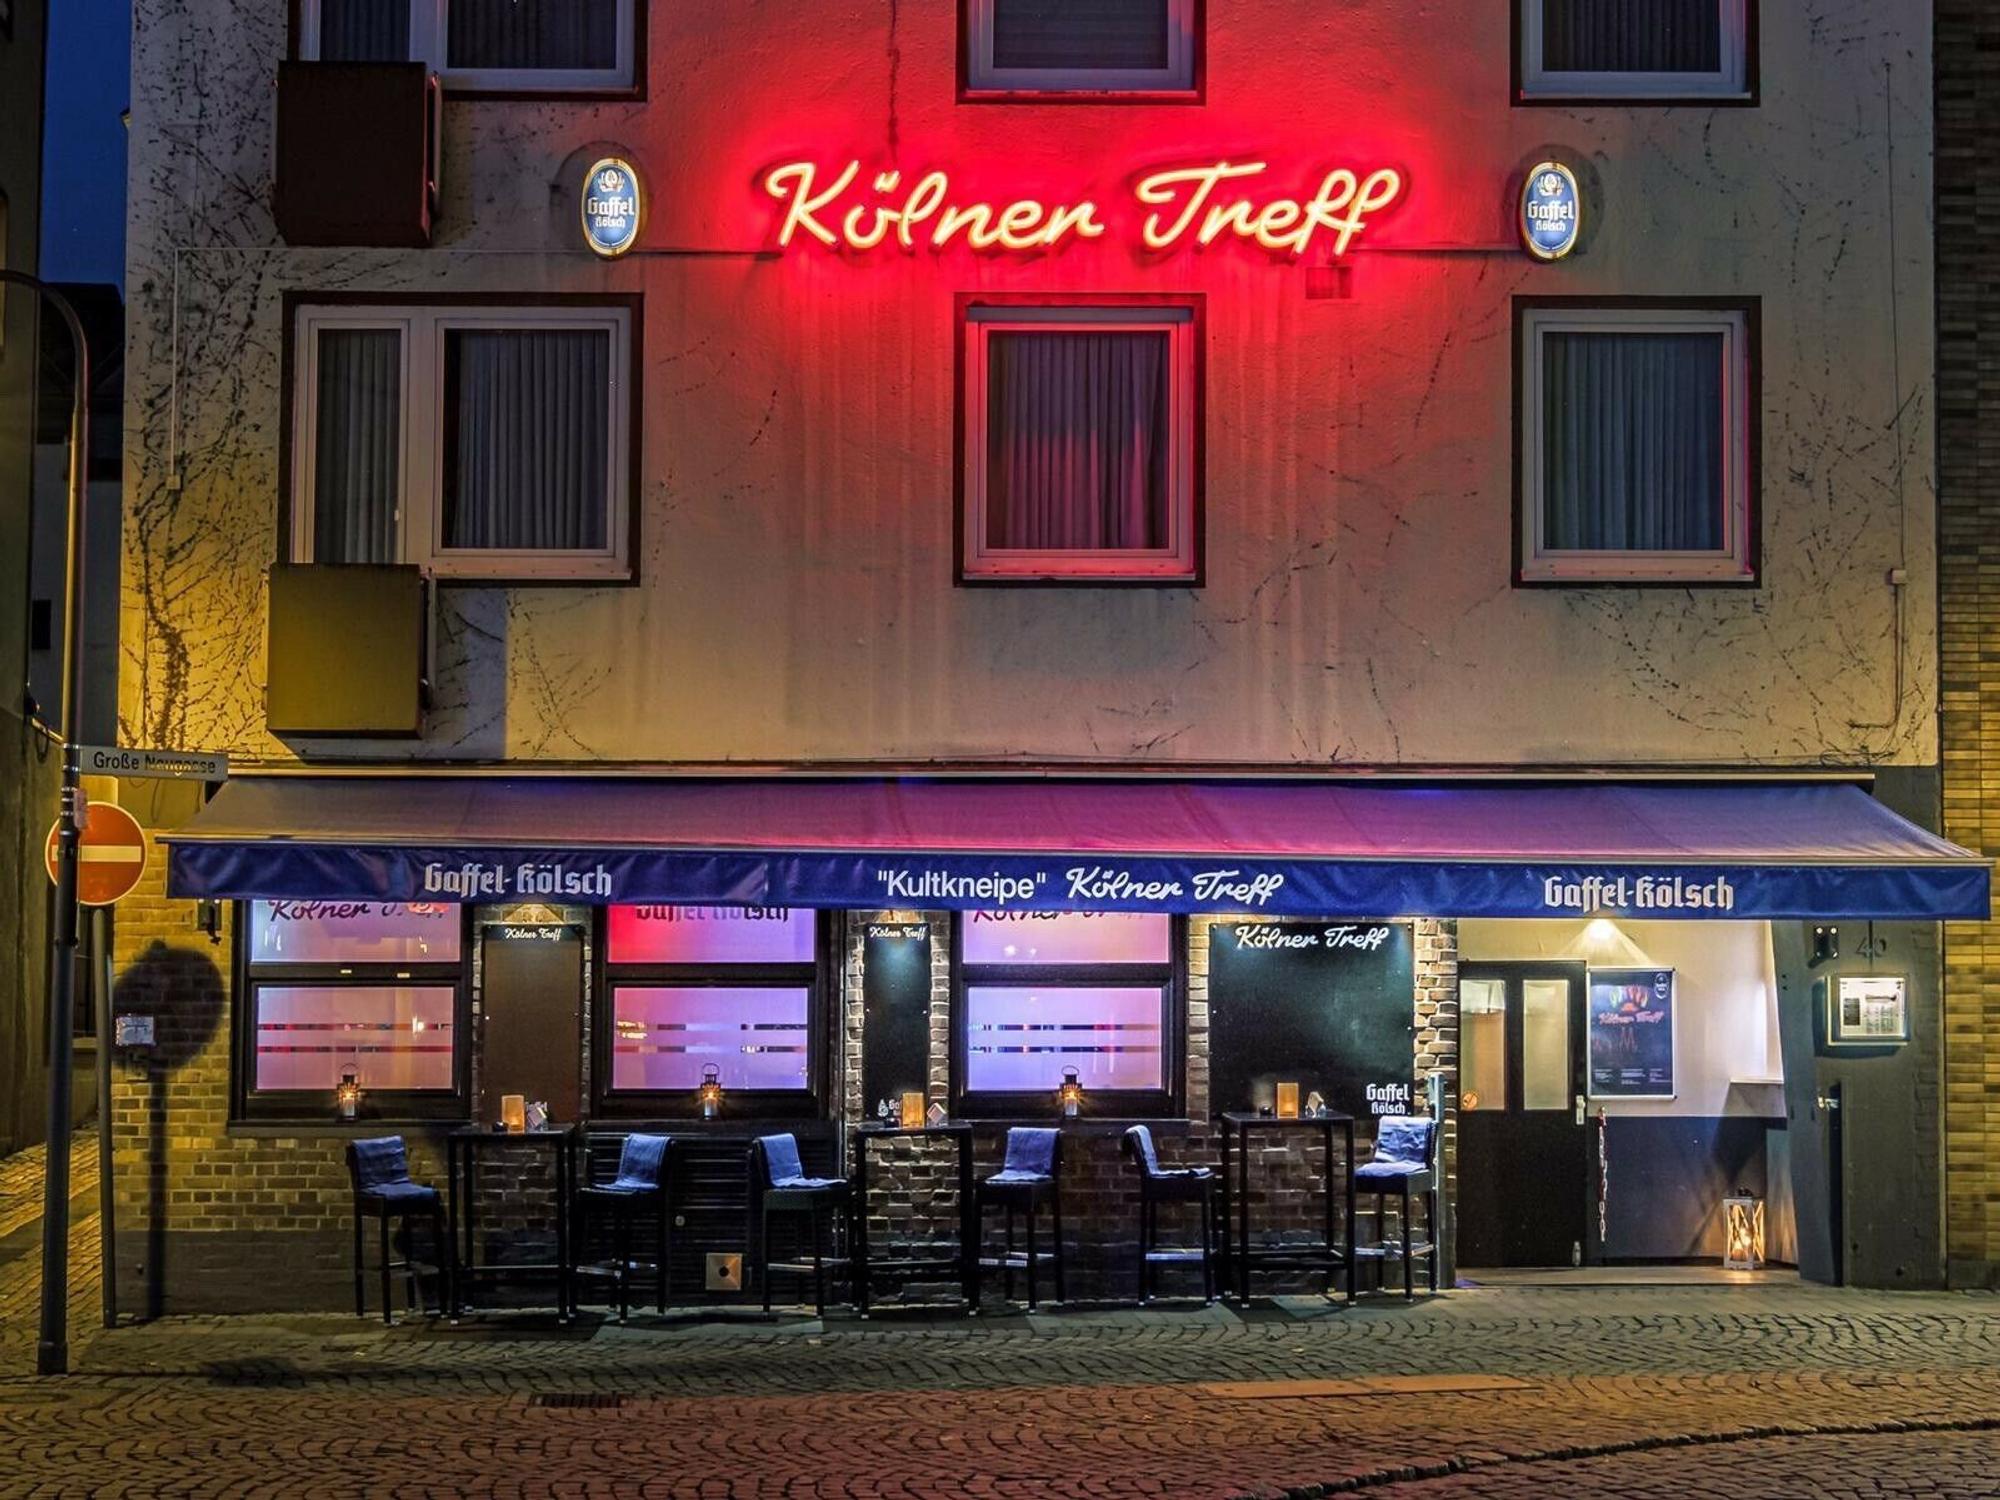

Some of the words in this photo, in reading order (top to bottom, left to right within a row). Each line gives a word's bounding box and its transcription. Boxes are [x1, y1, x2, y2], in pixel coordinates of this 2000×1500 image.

[587, 196, 635, 217] Gaffel
[766, 160, 1104, 249] Kölner
[1136, 161, 1400, 255] Treff
[1527, 200, 1575, 220] Gaffel
[93, 751, 140, 770] Große
[877, 870, 1047, 905] "Kultkneipe"
[1065, 866, 1183, 900] Kölner
[1192, 869, 1284, 906] Treff
[1235, 925, 1319, 949] Kölner
[1324, 925, 1389, 950] Treff
[1366, 1083, 1411, 1101] Gaffel
[1371, 1101, 1406, 1115] Kölsch
